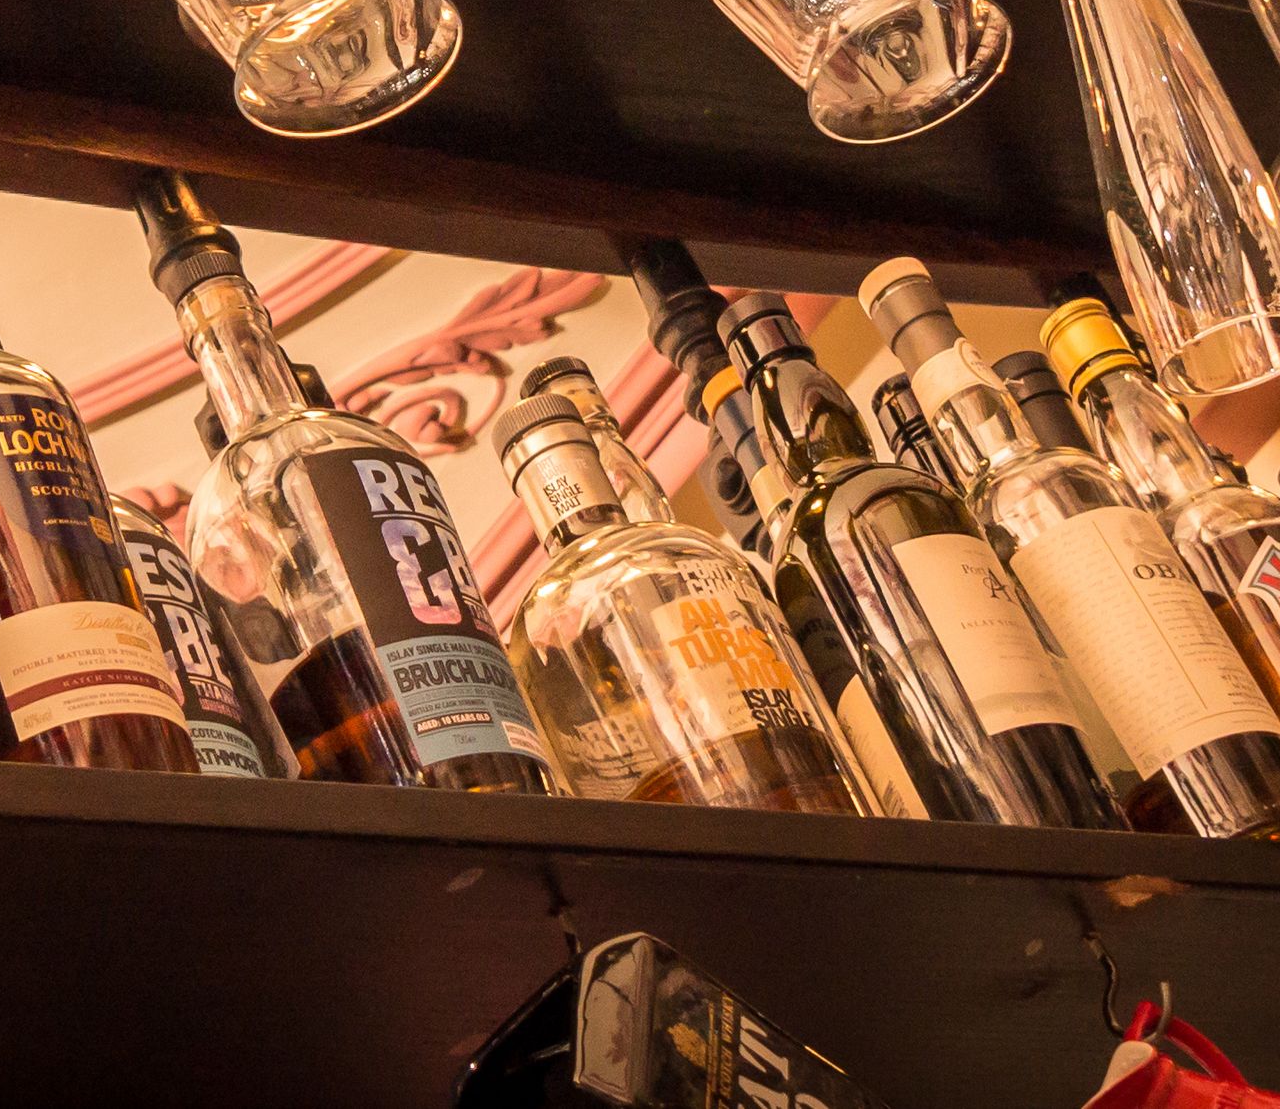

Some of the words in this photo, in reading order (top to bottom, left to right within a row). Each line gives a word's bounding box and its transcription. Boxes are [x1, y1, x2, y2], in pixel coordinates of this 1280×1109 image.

[544, 476, 569, 496] ISLAY
[548, 483, 584, 507] SINGLE
[555, 495, 582, 516] MALT
[678, 596, 727, 631] AN
[386, 648, 416, 663] ISLAY
[417, 642, 451, 656] SINGLE
[669, 626, 777, 669] TURAS
[12, 658, 55, 677] DOUBLE
[56, 648, 105, 661] MATURED
[742, 688, 795, 711] ISLAY
[417, 721, 440, 733] AGED:
[451, 714, 475, 725] YEARS
[476, 712, 491, 723] OLD
[196, 745, 261, 777] ATHMORE
